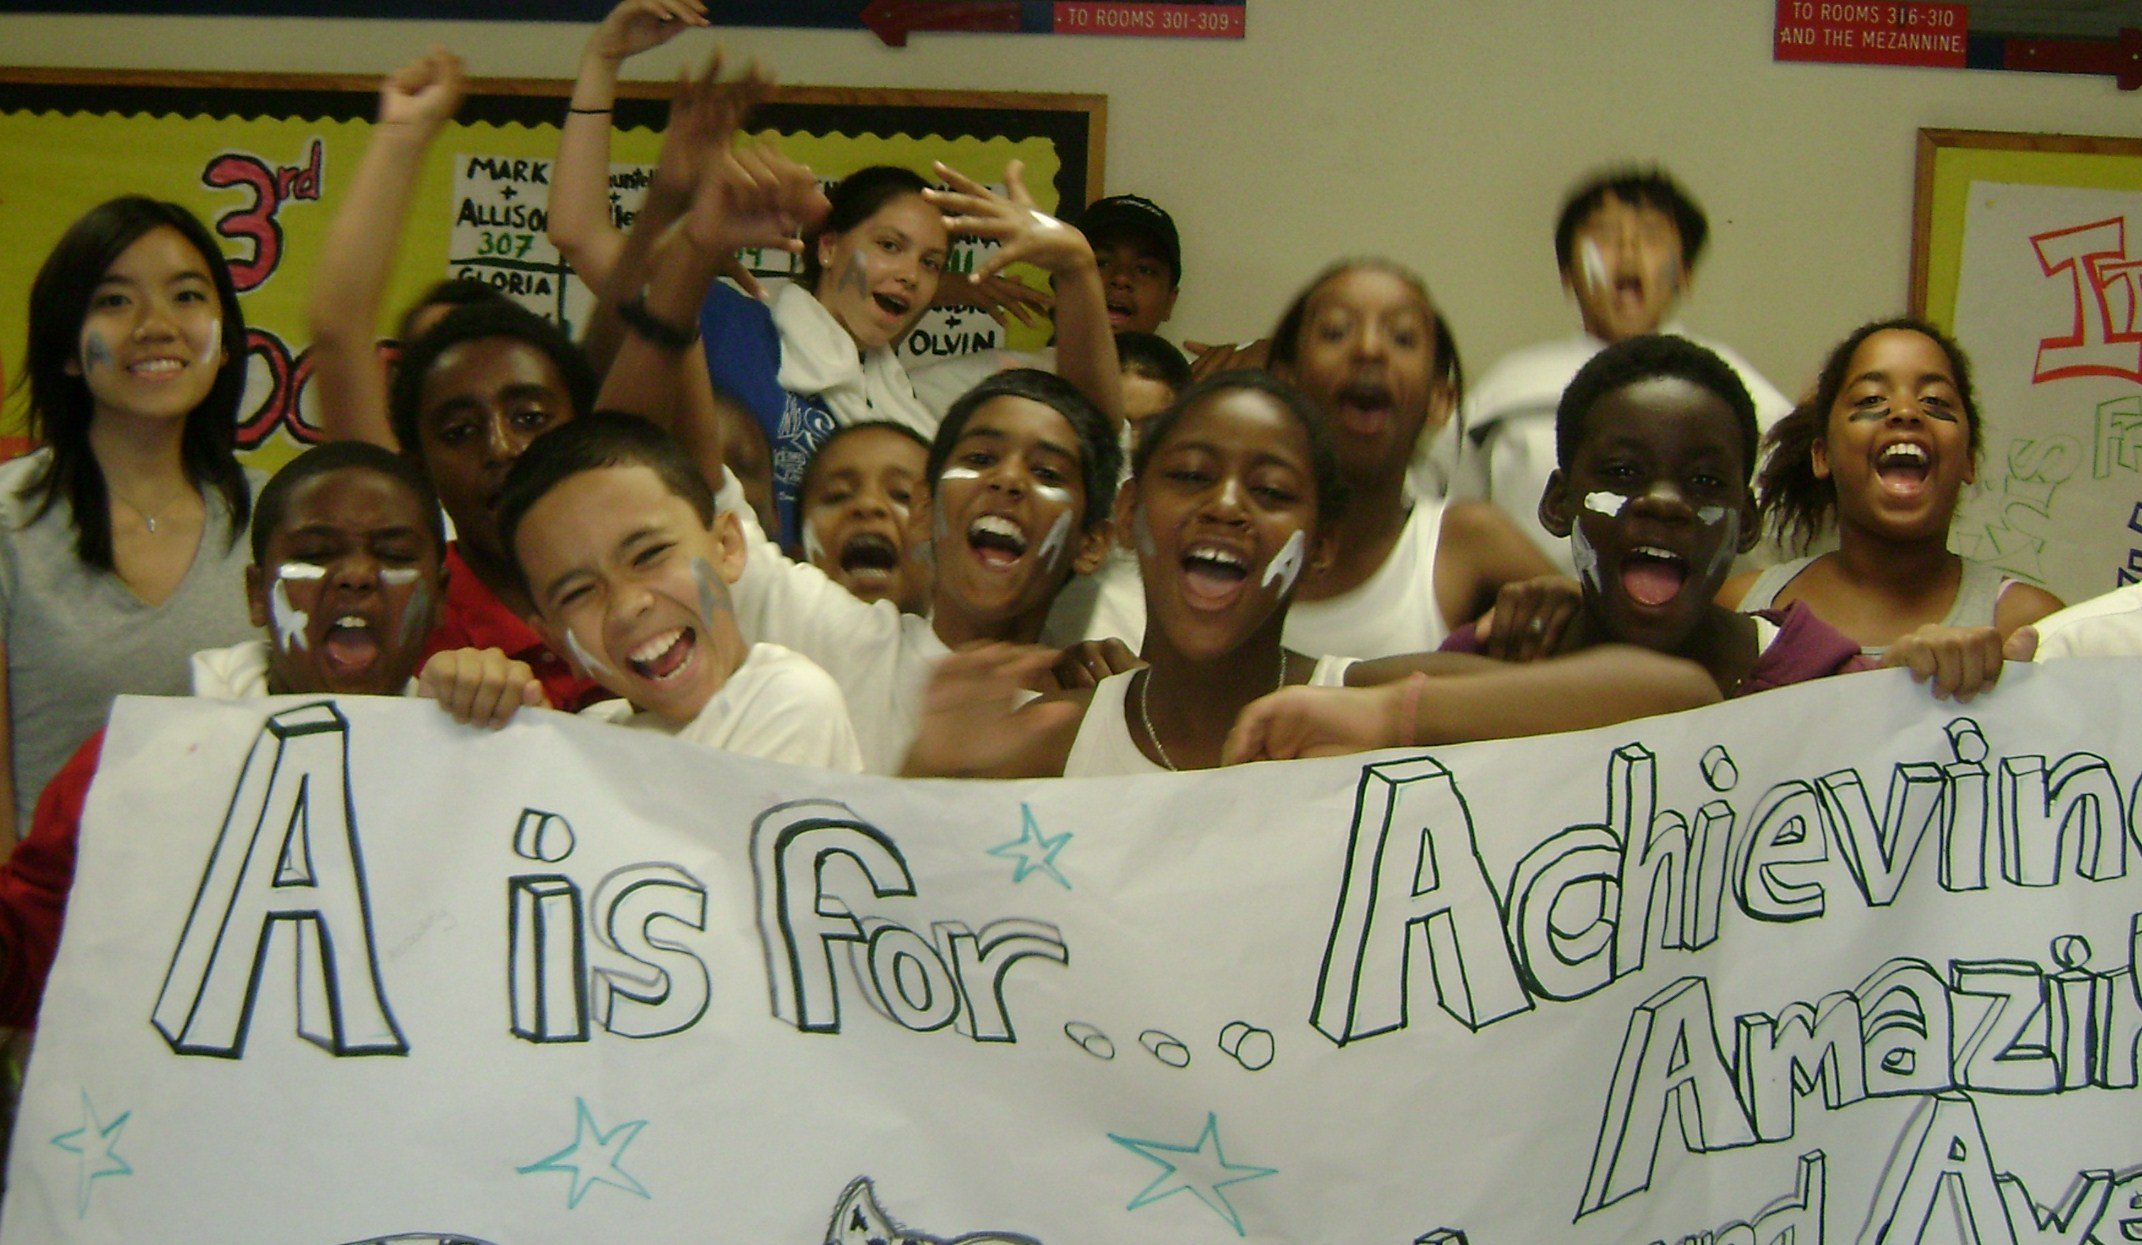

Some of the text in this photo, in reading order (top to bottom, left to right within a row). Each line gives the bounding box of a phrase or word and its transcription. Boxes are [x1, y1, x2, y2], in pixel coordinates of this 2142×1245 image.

[1069, 8, 1229, 30] TO ROOMS 301-309
[1793, 2, 1954, 26] TO ROOMS 316-310
[1780, 28, 1815, 44] AND
[1824, 29, 1853, 47] THE
[467, 157, 548, 185] MARK
[477, 232, 534, 257] 307
[908, 329, 995, 356] OLVIN
[150, 700, 410, 1060] A
[508, 808, 712, 1044] is
[1309, 717, 2142, 1047] Achievin
